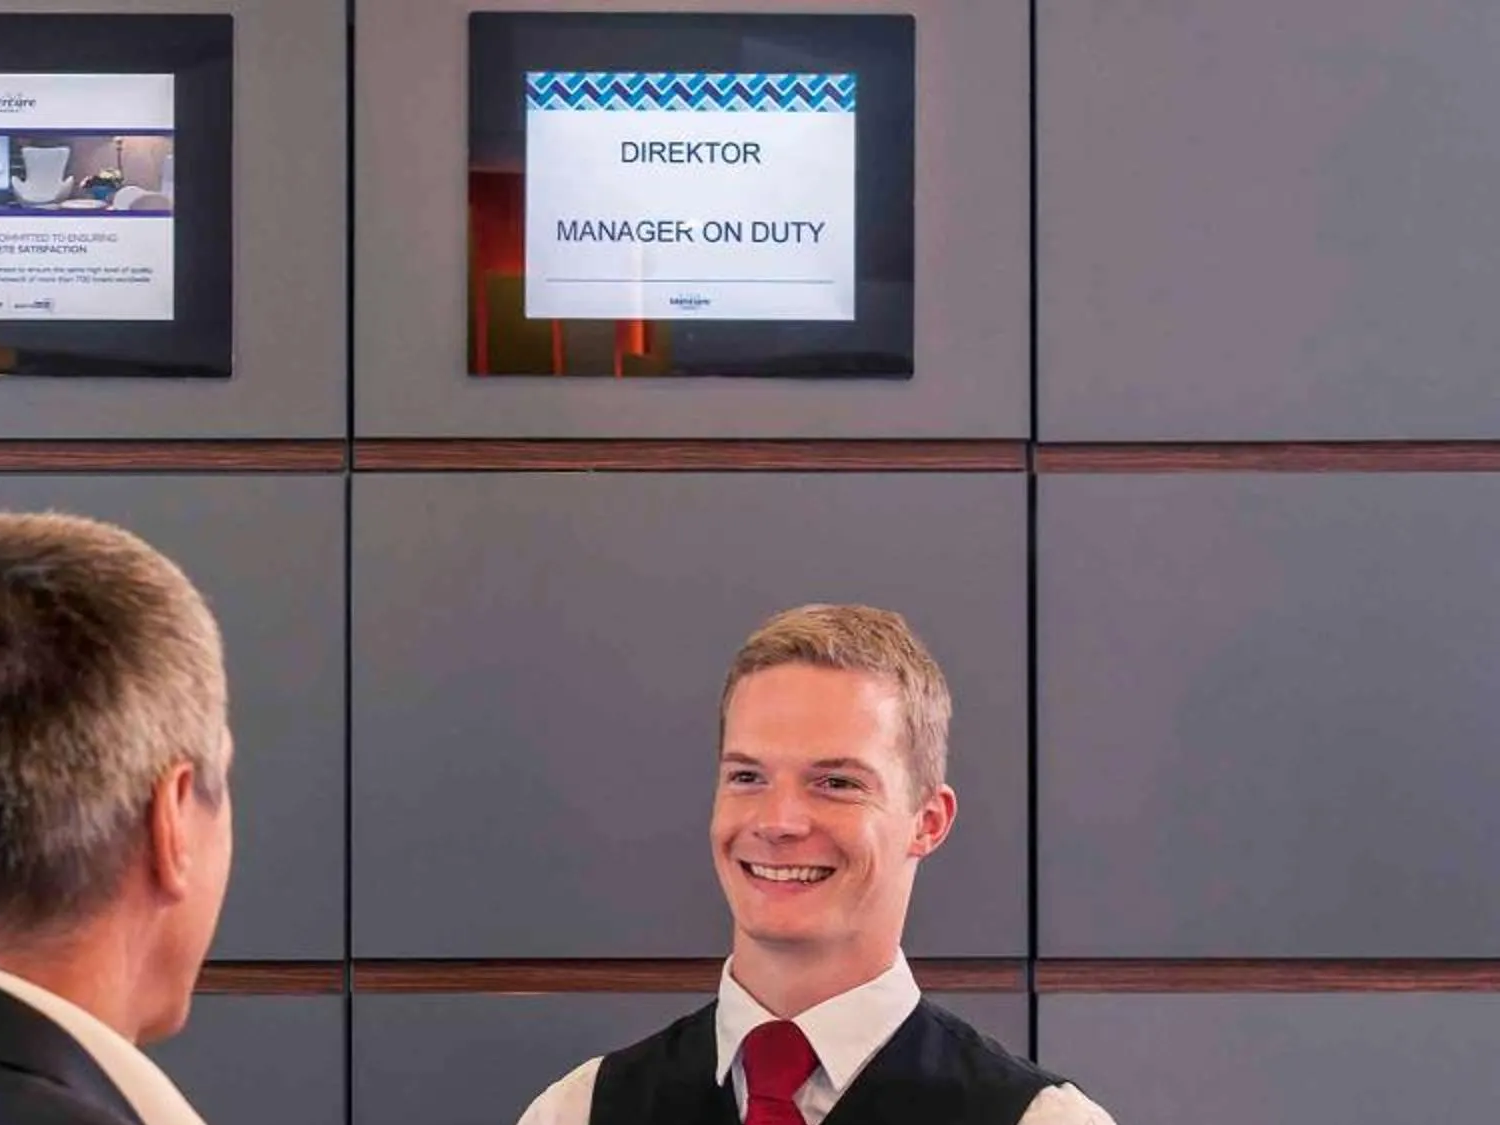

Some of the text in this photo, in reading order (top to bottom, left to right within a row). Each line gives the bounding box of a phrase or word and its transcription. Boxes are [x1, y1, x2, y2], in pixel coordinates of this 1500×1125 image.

[621, 141, 761, 164] DIREKTOR
[557, 220, 825, 243] MANAGER ON DUTY
[18, 245, 87, 254] SATISFACTION
